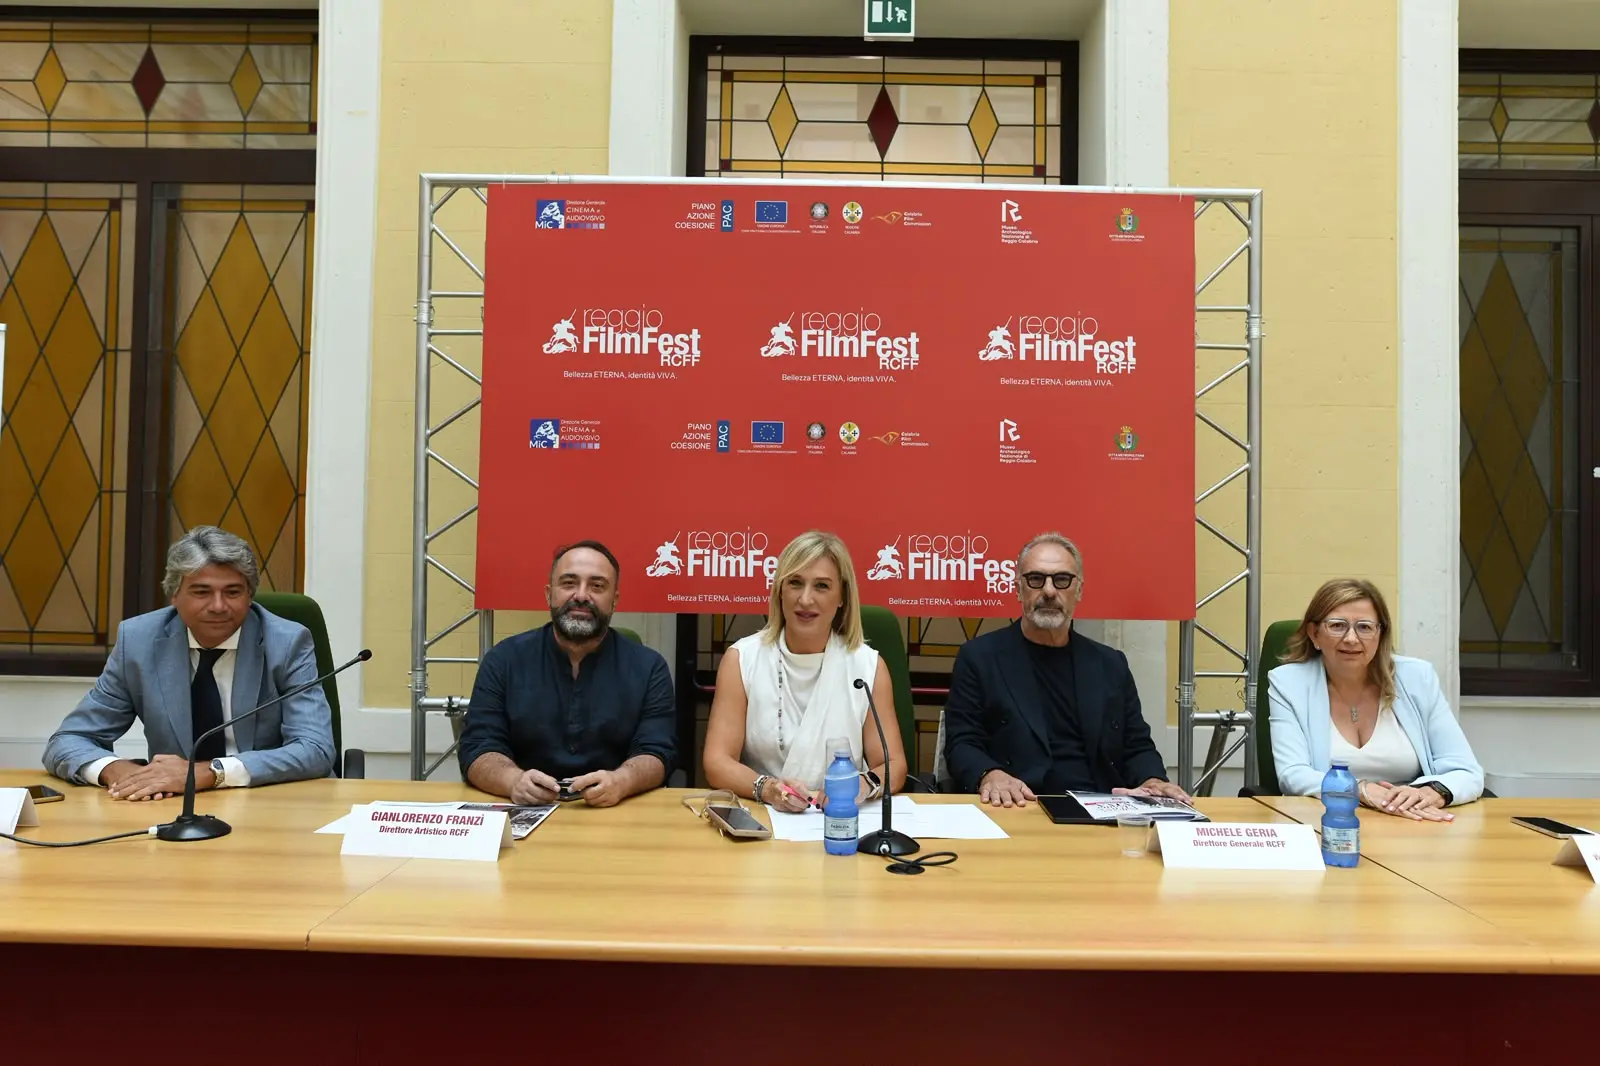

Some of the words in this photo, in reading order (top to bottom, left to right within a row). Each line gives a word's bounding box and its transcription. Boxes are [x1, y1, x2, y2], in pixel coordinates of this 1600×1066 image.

[687, 212, 715, 220] AZIONE
[722, 205, 732, 228] PAC
[535, 220, 553, 229] MiC
[675, 221, 715, 229] COESIONE
[583, 304, 663, 334] reggio
[801, 307, 881, 337] reggio
[1019, 310, 1099, 341] reggio
[583, 326, 701, 355] FilmFest
[801, 329, 920, 359] FilmFest
[1019, 333, 1137, 362] FilmFest
[660, 355, 701, 367] RCFF
[879, 358, 919, 370] RCFF
[1096, 361, 1136, 374] RCFF
[563, 370, 592, 378] Bellezza
[593, 371, 627, 379] ETERNA,
[628, 371, 656, 379] identità
[656, 371, 678, 379] VIVA.
[812, 375, 846, 383] ETERNA,
[847, 375, 874, 383] identità
[1000, 377, 1030, 385] Bellezza
[1030, 378, 1064, 387] ETERNA,
[1065, 379, 1092, 387] identità
[682, 432, 711, 440] AZIONE
[718, 425, 729, 448] PAC
[529, 440, 548, 449] MiC
[670, 442, 711, 450] COESIONE
[687, 526, 768, 557] reggio
[908, 529, 989, 560] reggio
[687, 549, 779, 577] FilmFe
[908, 552, 1018, 582] FilmFes
[986, 580, 1016, 594] RCF
[667, 594, 697, 602] Bellezza
[698, 594, 732, 603] ETERNA,
[733, 595, 761, 603] identità
[888, 597, 919, 605] Bellezza
[919, 598, 953, 607] ETERNA,
[954, 598, 982, 607] identità
[983, 599, 1005, 607] VIVA.
[371, 811, 443, 825] GIANLORENZO
[379, 825, 413, 834] Direttore
[414, 826, 448, 836] Artistico
[449, 828, 470, 837] RCFF
[1196, 827, 1243, 837] MICHELE
[1246, 828, 1278, 838] GERIA
[1193, 839, 1228, 848] Direttore
[1229, 840, 1265, 848] Generale
[1266, 840, 1286, 848] RCFF
